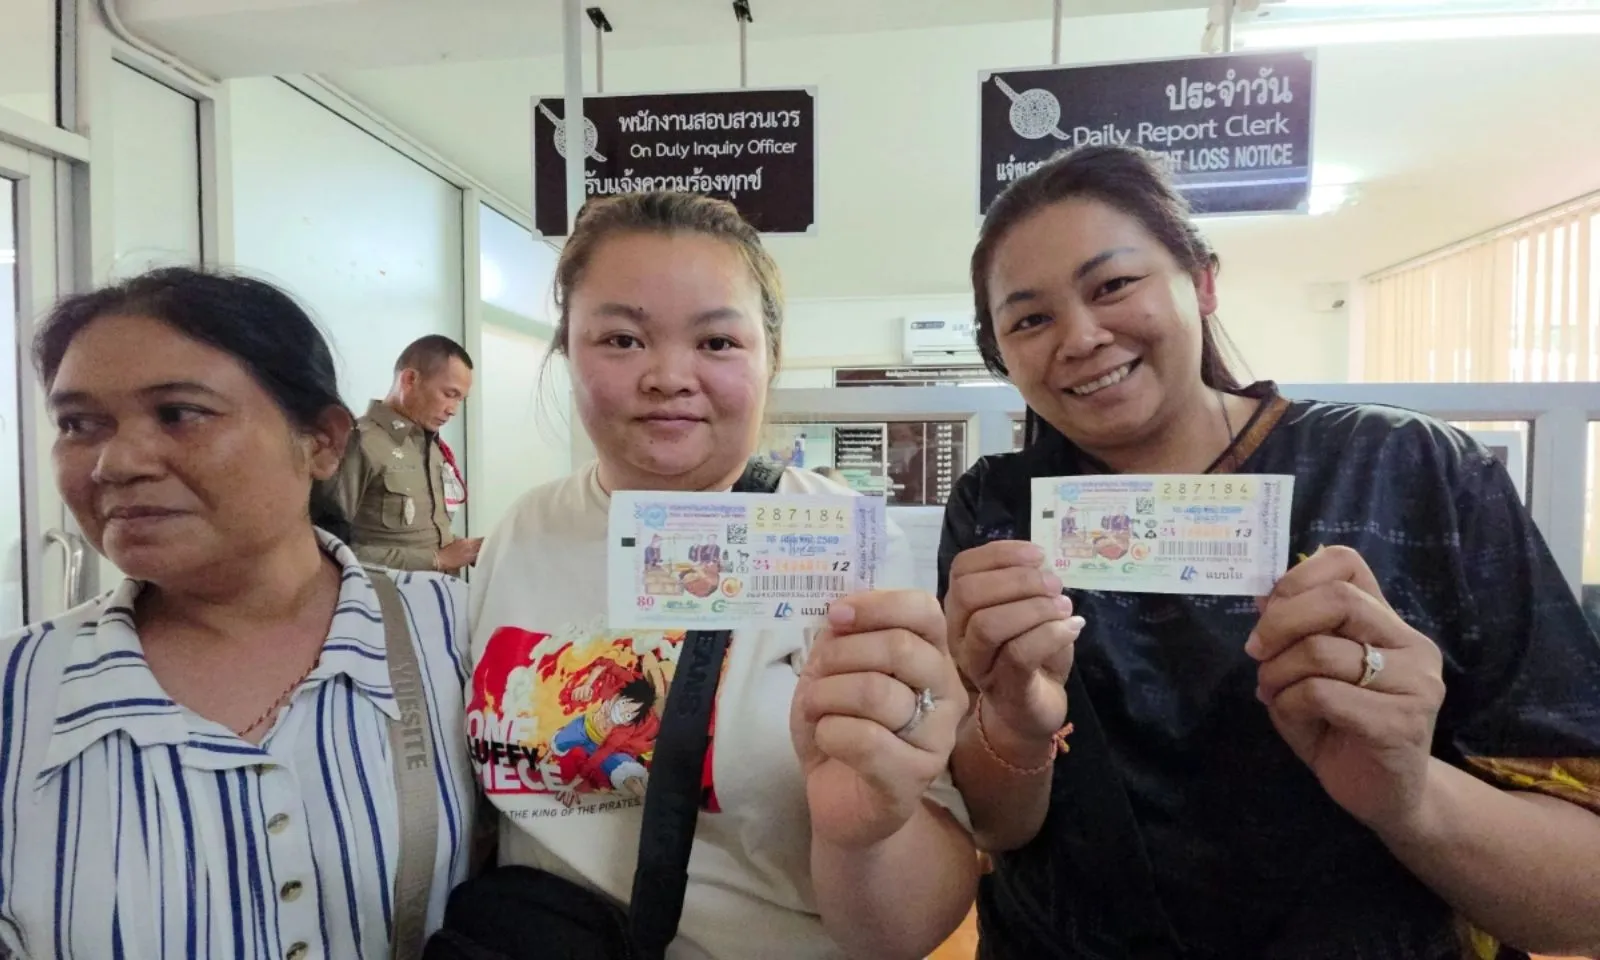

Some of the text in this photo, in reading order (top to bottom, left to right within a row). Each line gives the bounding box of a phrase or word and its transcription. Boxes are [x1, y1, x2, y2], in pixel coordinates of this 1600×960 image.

[1165, 67, 1293, 111] ประจำวัน
[618, 109, 800, 133] พนักงานสอบสวนเวร
[1072, 112, 1290, 147] Daily Report Clerk
[630, 143, 651, 158] On
[694, 140, 743, 161] Inquiry
[747, 139, 797, 155] Officer
[1189, 148, 1229, 171] LOSS
[1236, 144, 1293, 169] NOTICE
[1163, 483, 1248, 494] 287184
[756, 507, 844, 522] 287184
[1235, 528, 1253, 538] 13
[832, 560, 851, 572] 12
[466, 709, 538, 747] ONE
[509, 809, 528, 819] THE
[531, 808, 557, 818] KING
[561, 807, 574, 817] OF
[577, 804, 598, 814] THE
